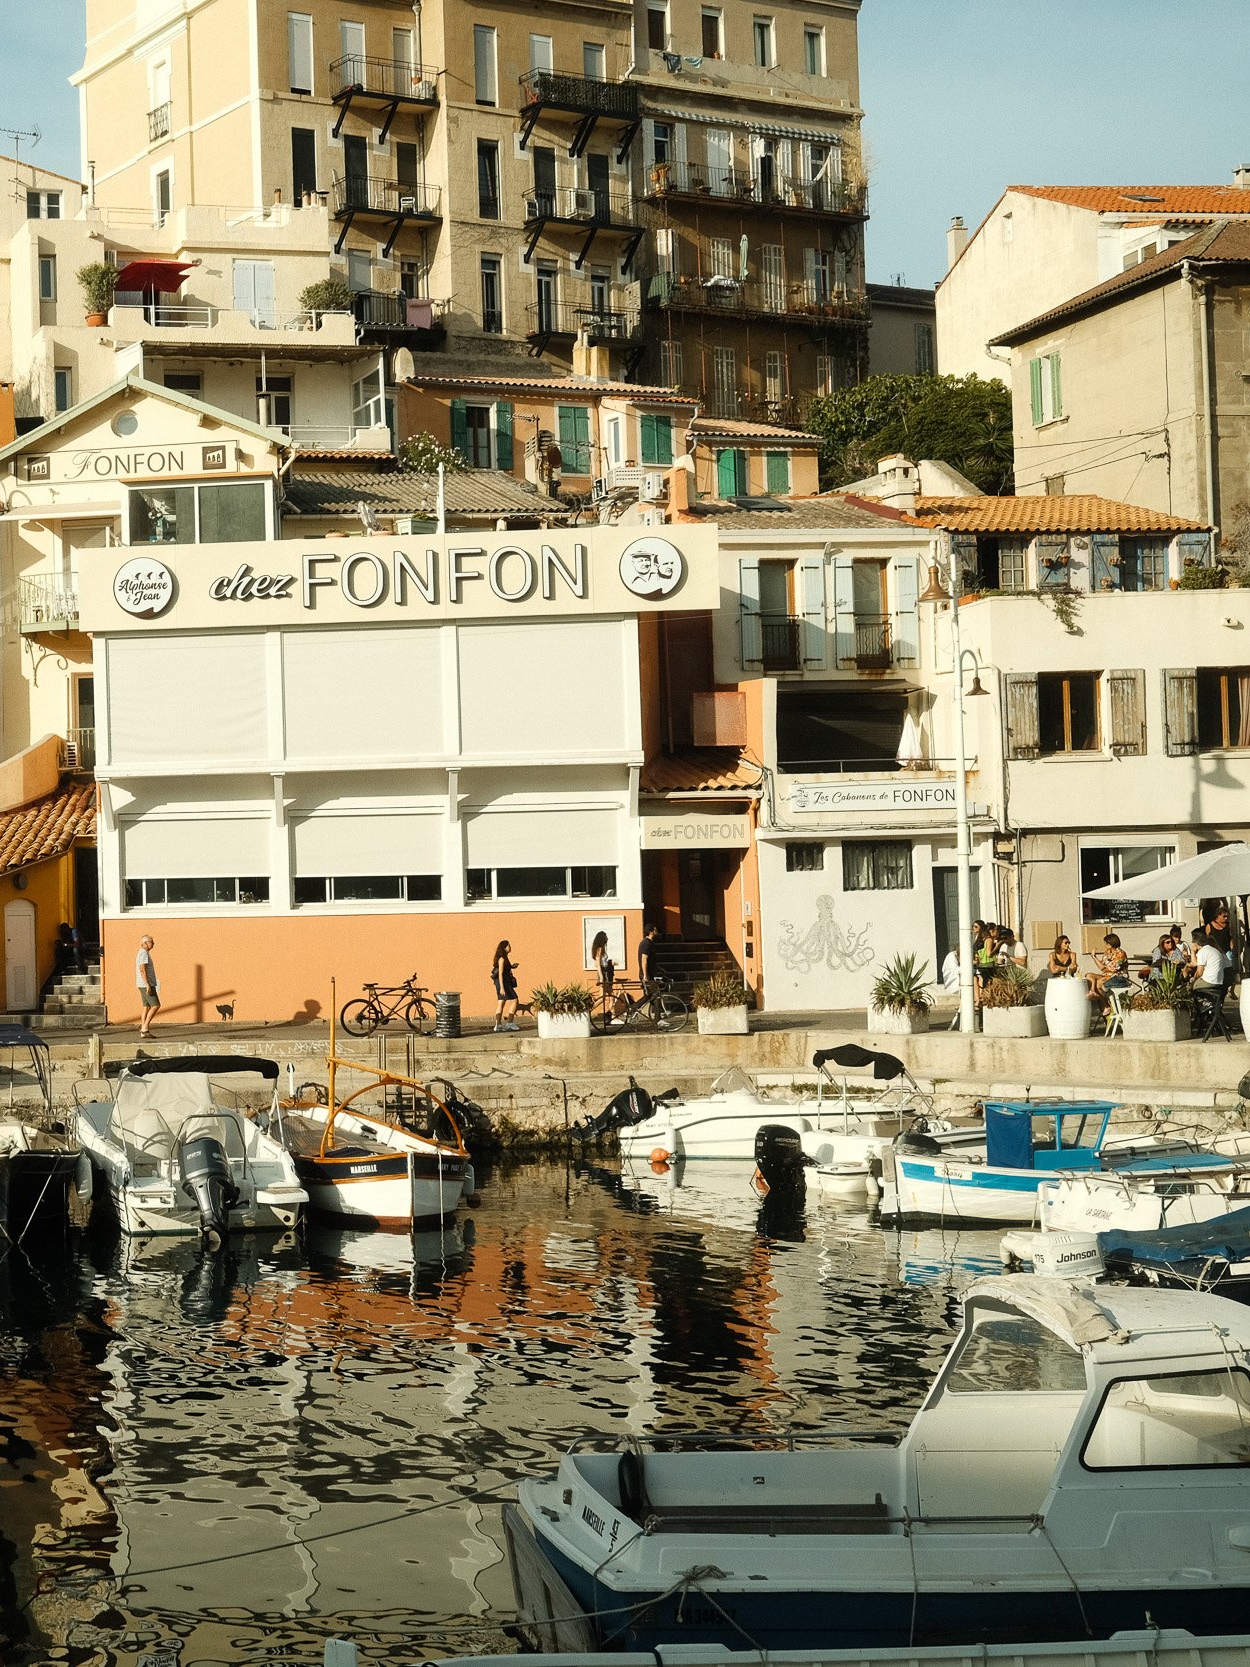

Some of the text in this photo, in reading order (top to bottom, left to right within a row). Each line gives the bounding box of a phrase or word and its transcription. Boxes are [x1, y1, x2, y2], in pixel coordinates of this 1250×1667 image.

[64, 450, 184, 479] FONFON
[209, 544, 587, 608] chez FONFON
[118, 579, 168, 594] Alphonse
[133, 591, 162, 605] Jean
[813, 791, 829, 805] Les
[879, 791, 889, 800] de
[893, 788, 956, 803] FONFON
[673, 824, 745, 839] FONFON
[350, 1164, 377, 1174] MARSEILLE
[1034, 1253, 1045, 1263] 175
[1056, 1249, 1097, 1263] Johnson
[582, 1505, 605, 1537] MARSEILLE
